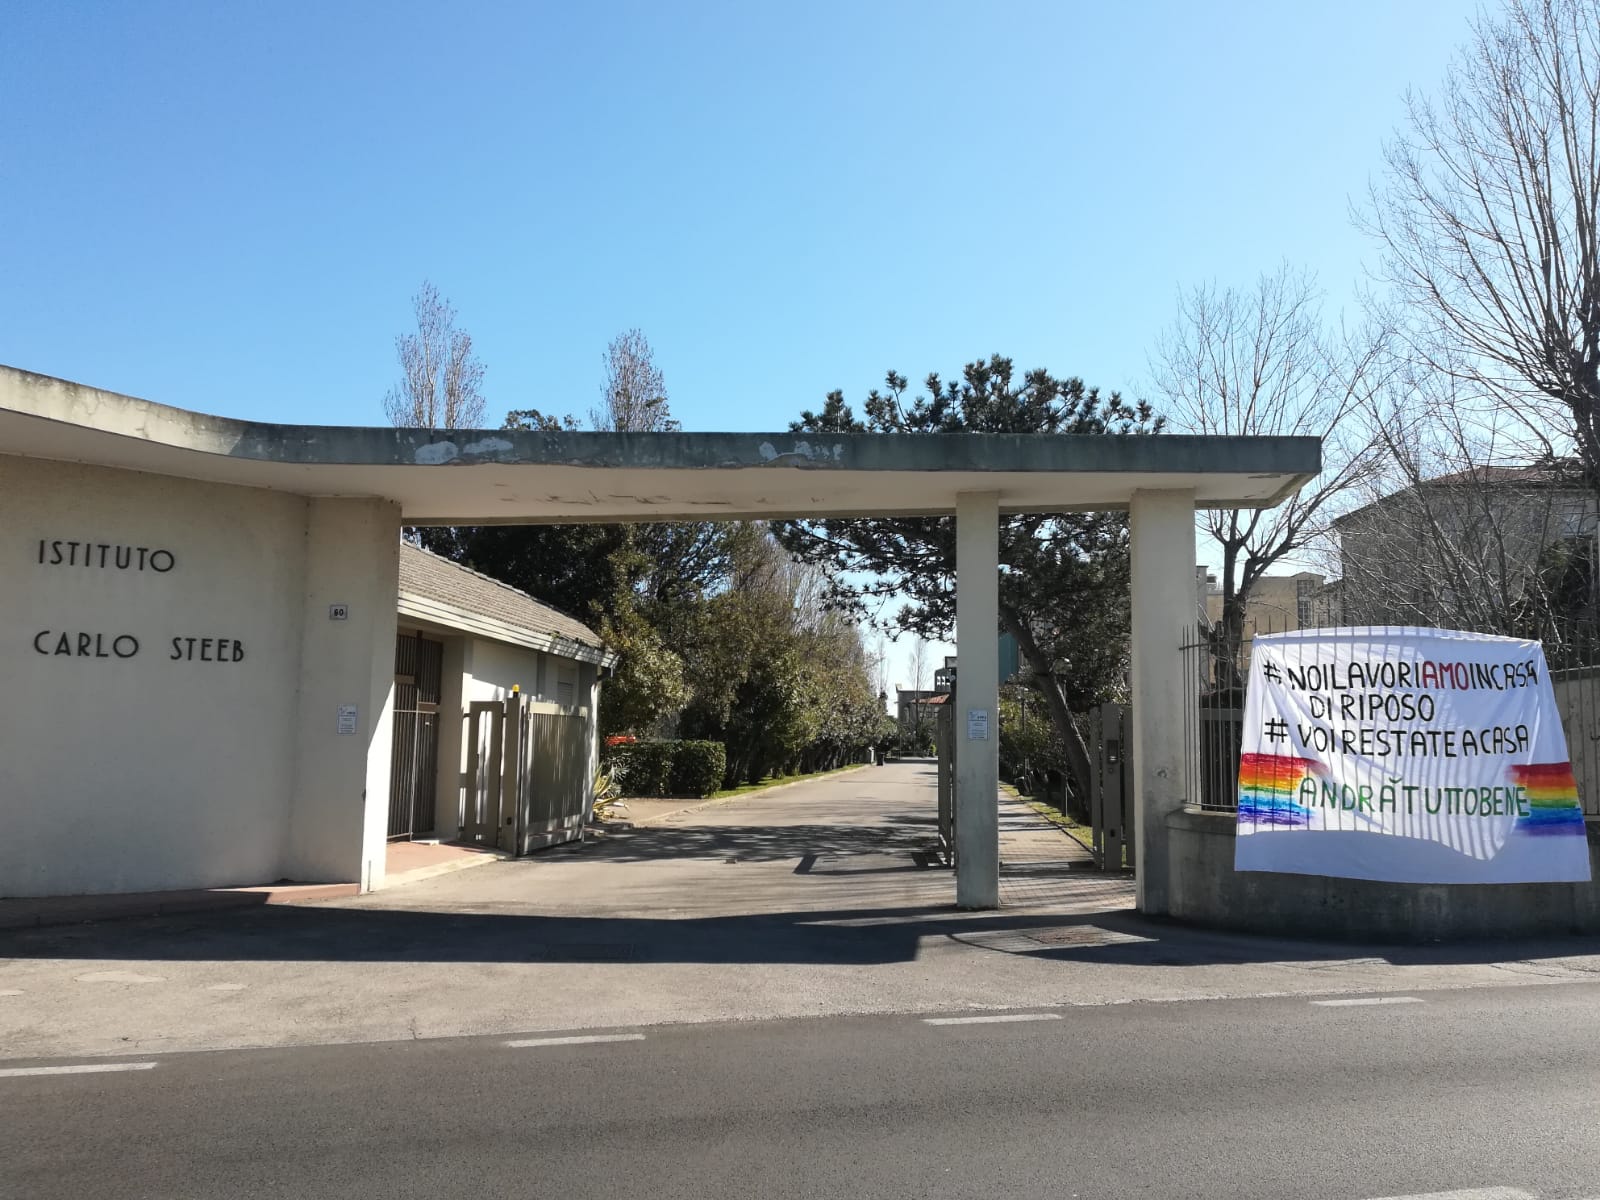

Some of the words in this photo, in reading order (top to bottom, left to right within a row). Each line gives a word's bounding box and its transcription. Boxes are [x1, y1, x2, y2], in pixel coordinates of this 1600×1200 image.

[38, 539, 175, 572] ISTITUTO
[33, 630, 139, 659] CARLO
[170, 637, 245, 662] STEEB
